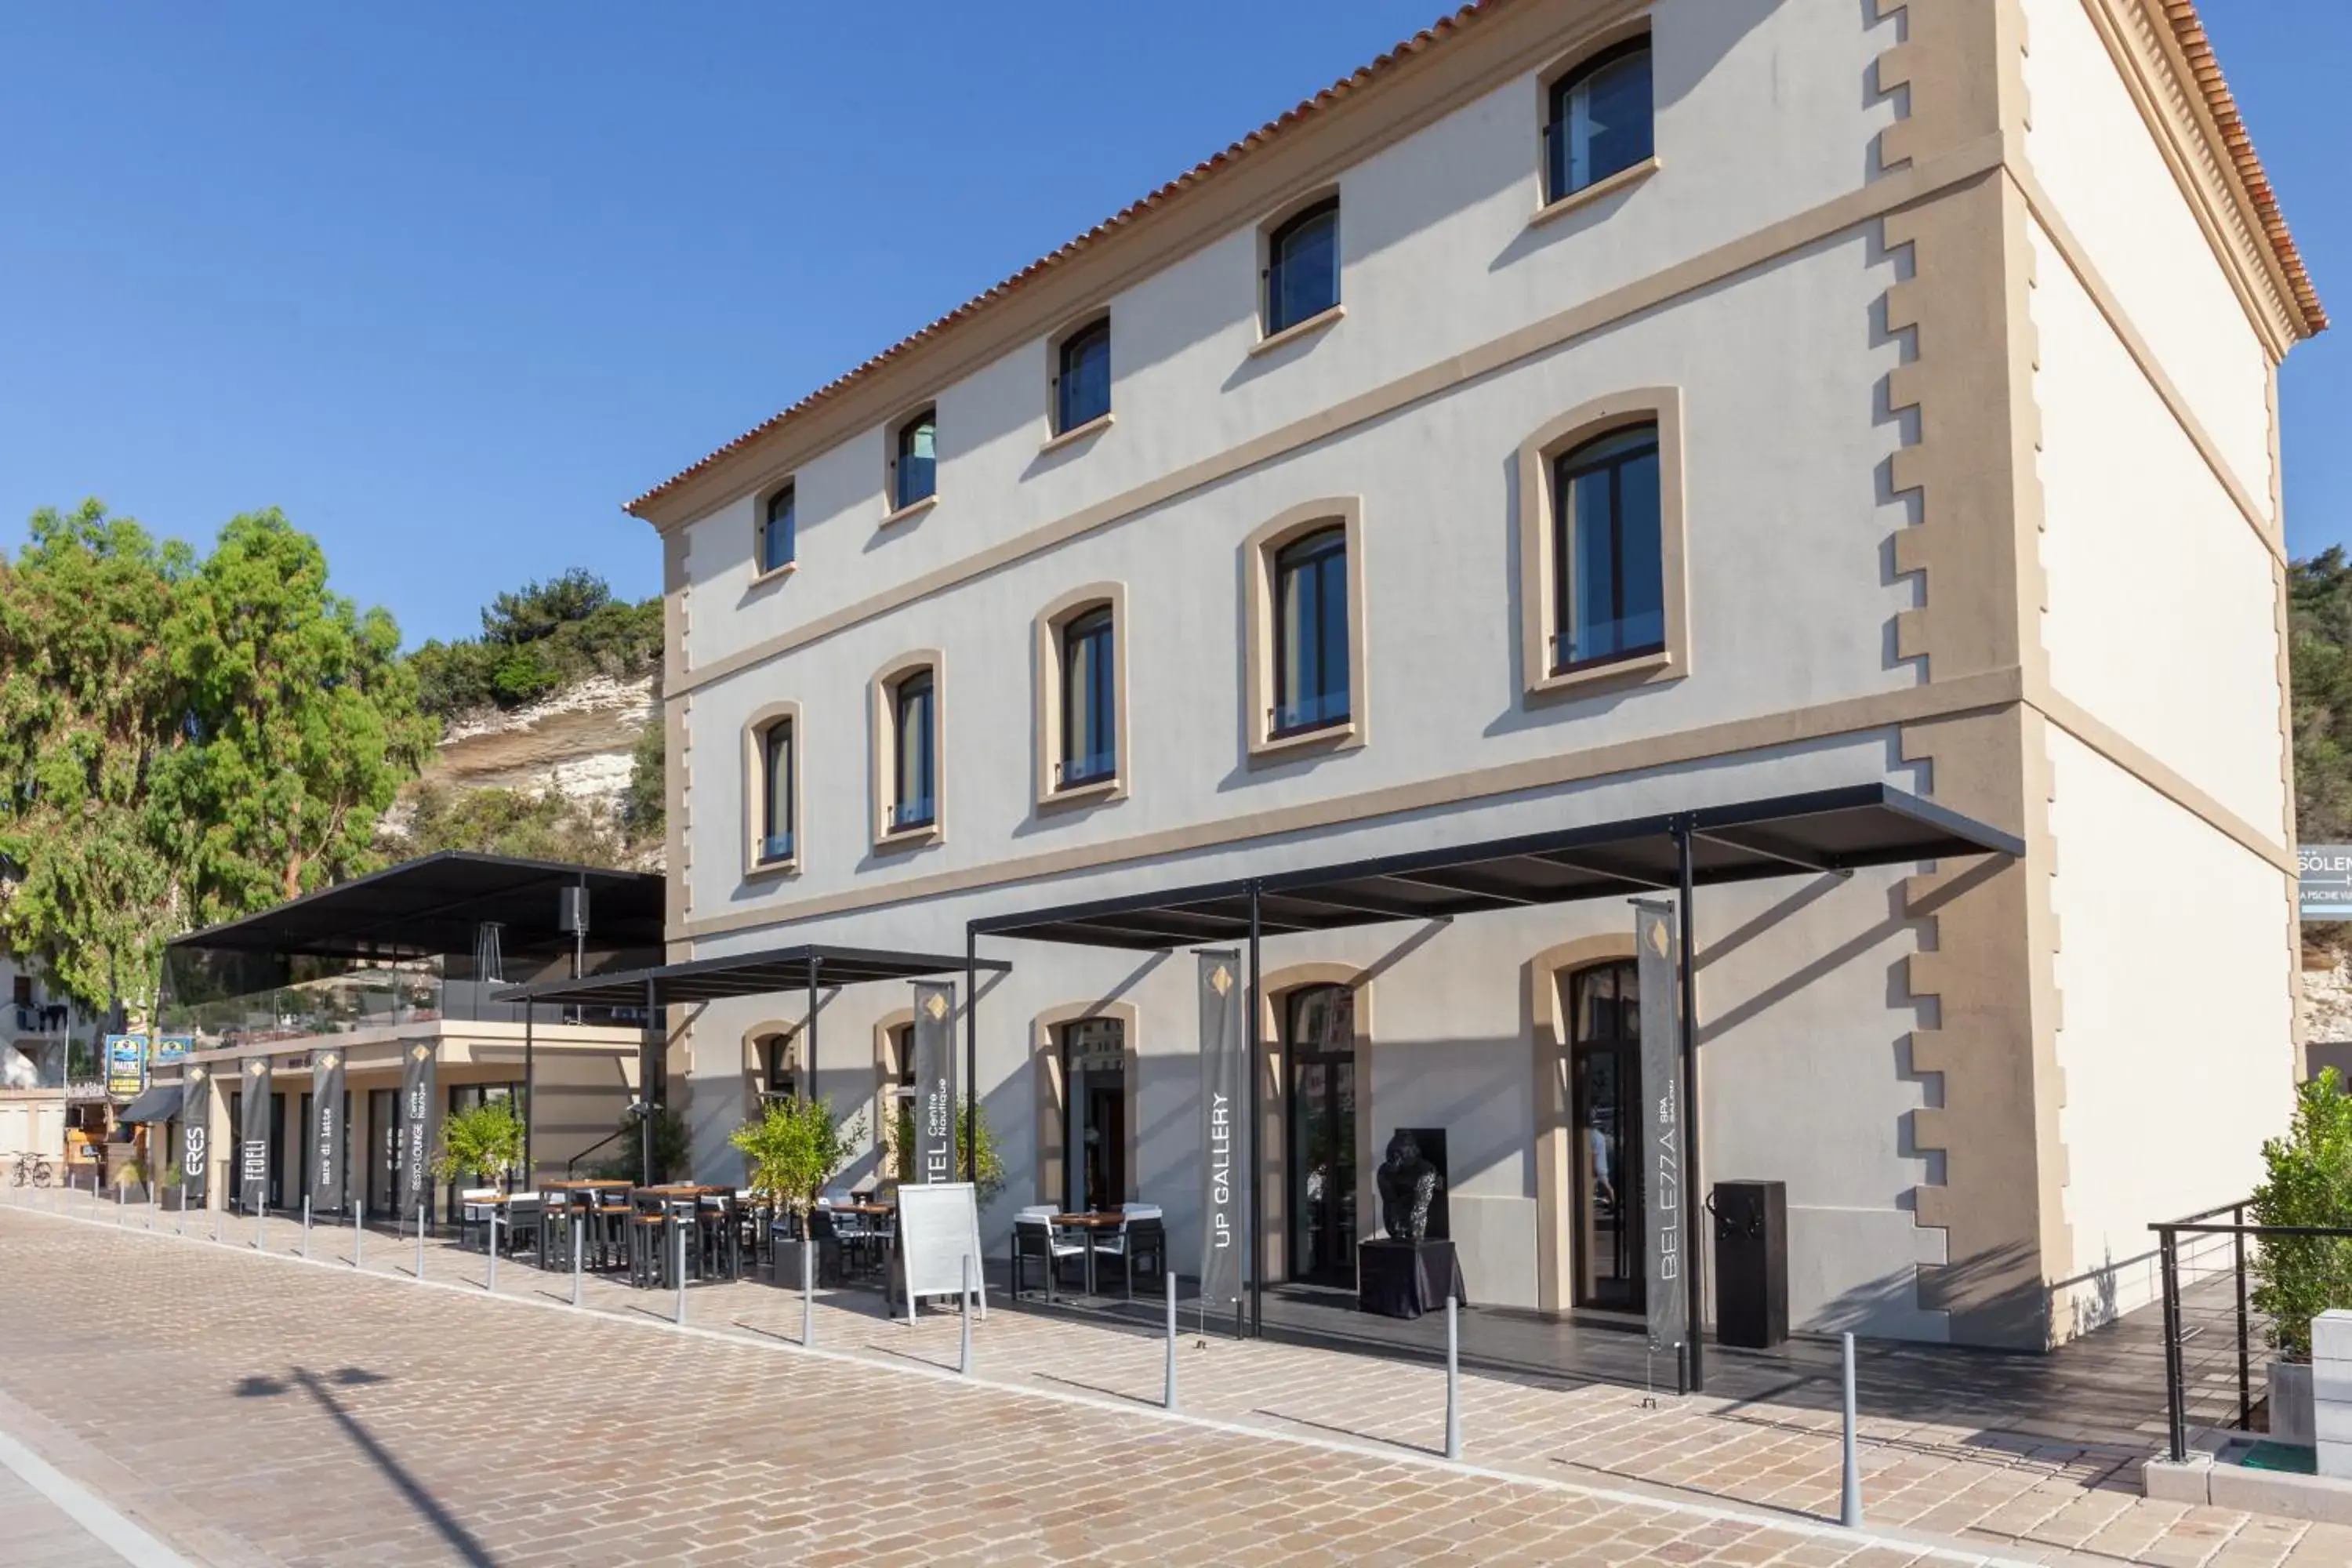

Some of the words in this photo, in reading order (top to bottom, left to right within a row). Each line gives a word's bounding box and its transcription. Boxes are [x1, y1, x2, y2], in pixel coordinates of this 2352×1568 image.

[927, 1093, 938, 1137] Centre
[938, 1078, 947, 1137] Nautique
[1660, 1097, 1668, 1123] SPA
[187, 1127, 204, 1176] ERES
[245, 1140, 266, 1181] FEDELI
[320, 1143, 331, 1156] di
[927, 1141, 946, 1185] TEL
[1212, 1092, 1229, 1205] GALLERY
[1659, 1128, 1678, 1279] BELEZZA
[1215, 1213, 1230, 1248] UP
